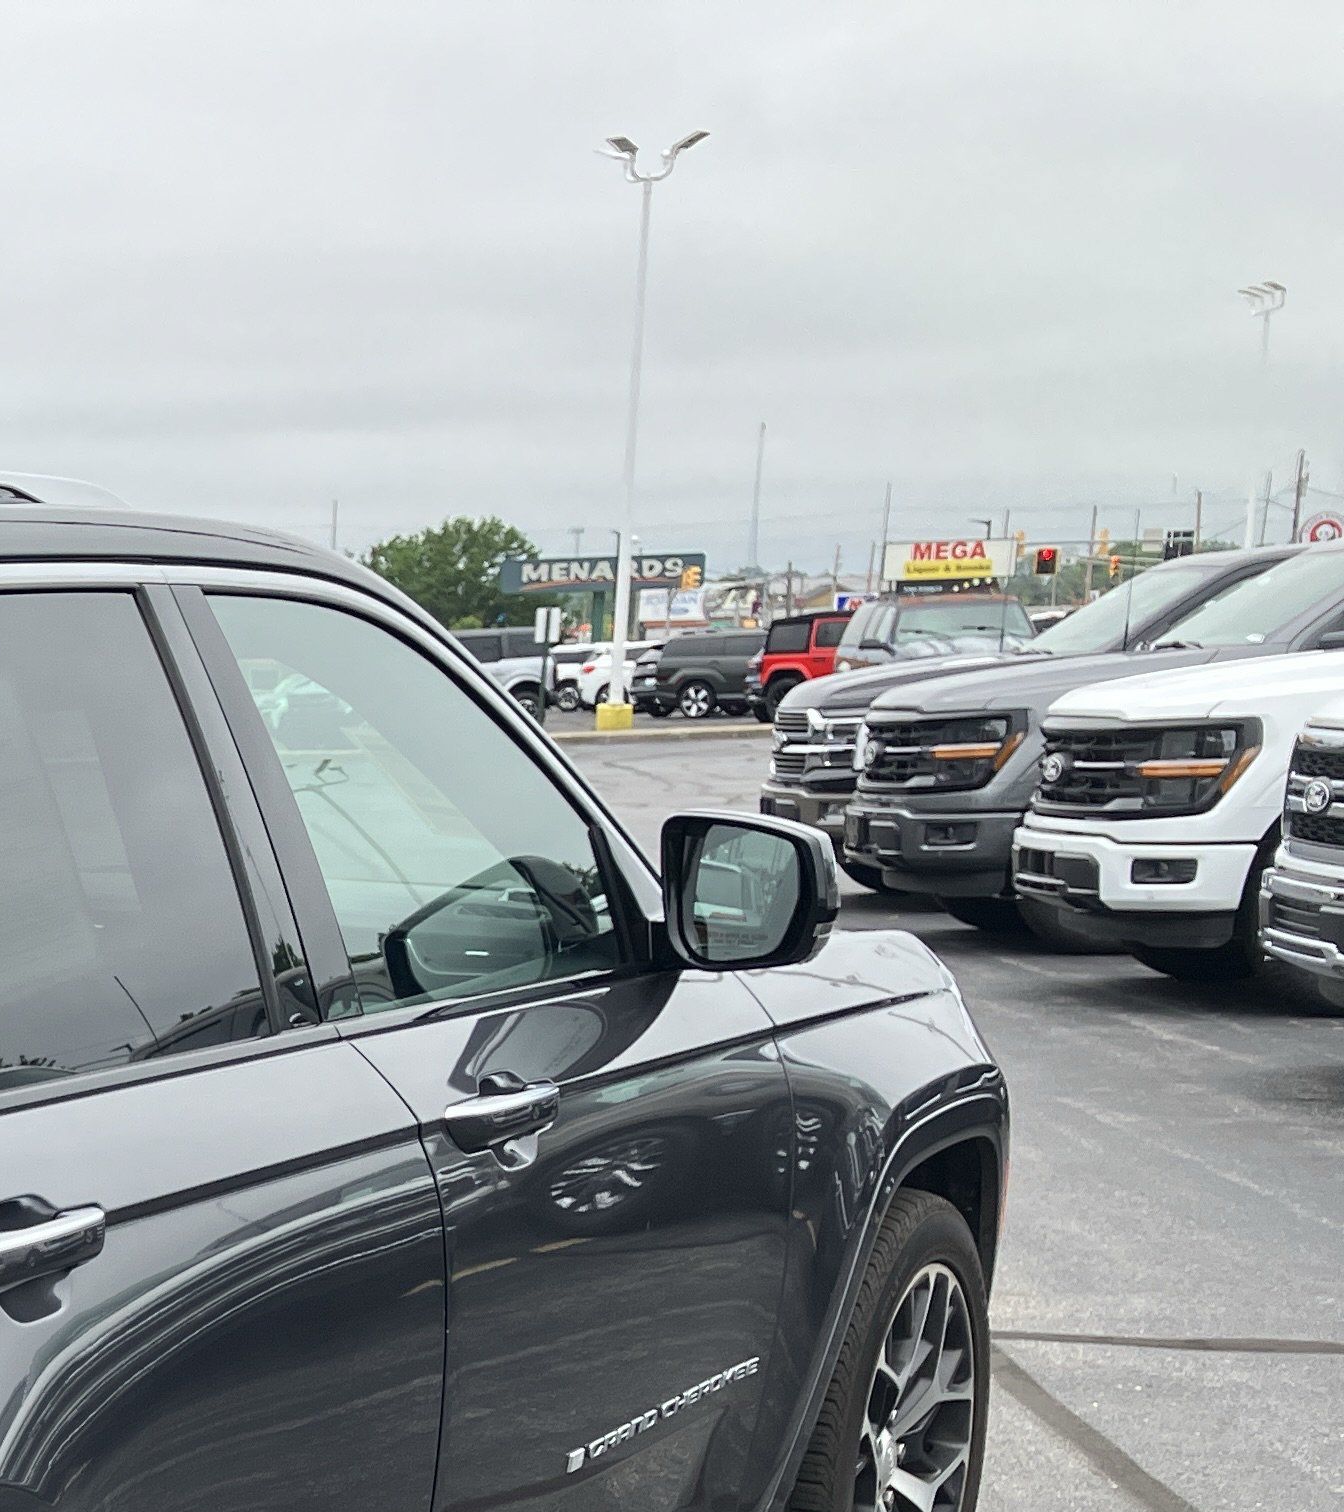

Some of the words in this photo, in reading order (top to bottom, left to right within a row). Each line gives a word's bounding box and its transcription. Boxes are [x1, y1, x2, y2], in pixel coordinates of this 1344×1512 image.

[911, 540, 987, 560] MEGA
[520, 557, 685, 584] MENARDS
[587, 1408, 659, 1459] GRAND
[662, 1356, 760, 1418] CHEROKEE
